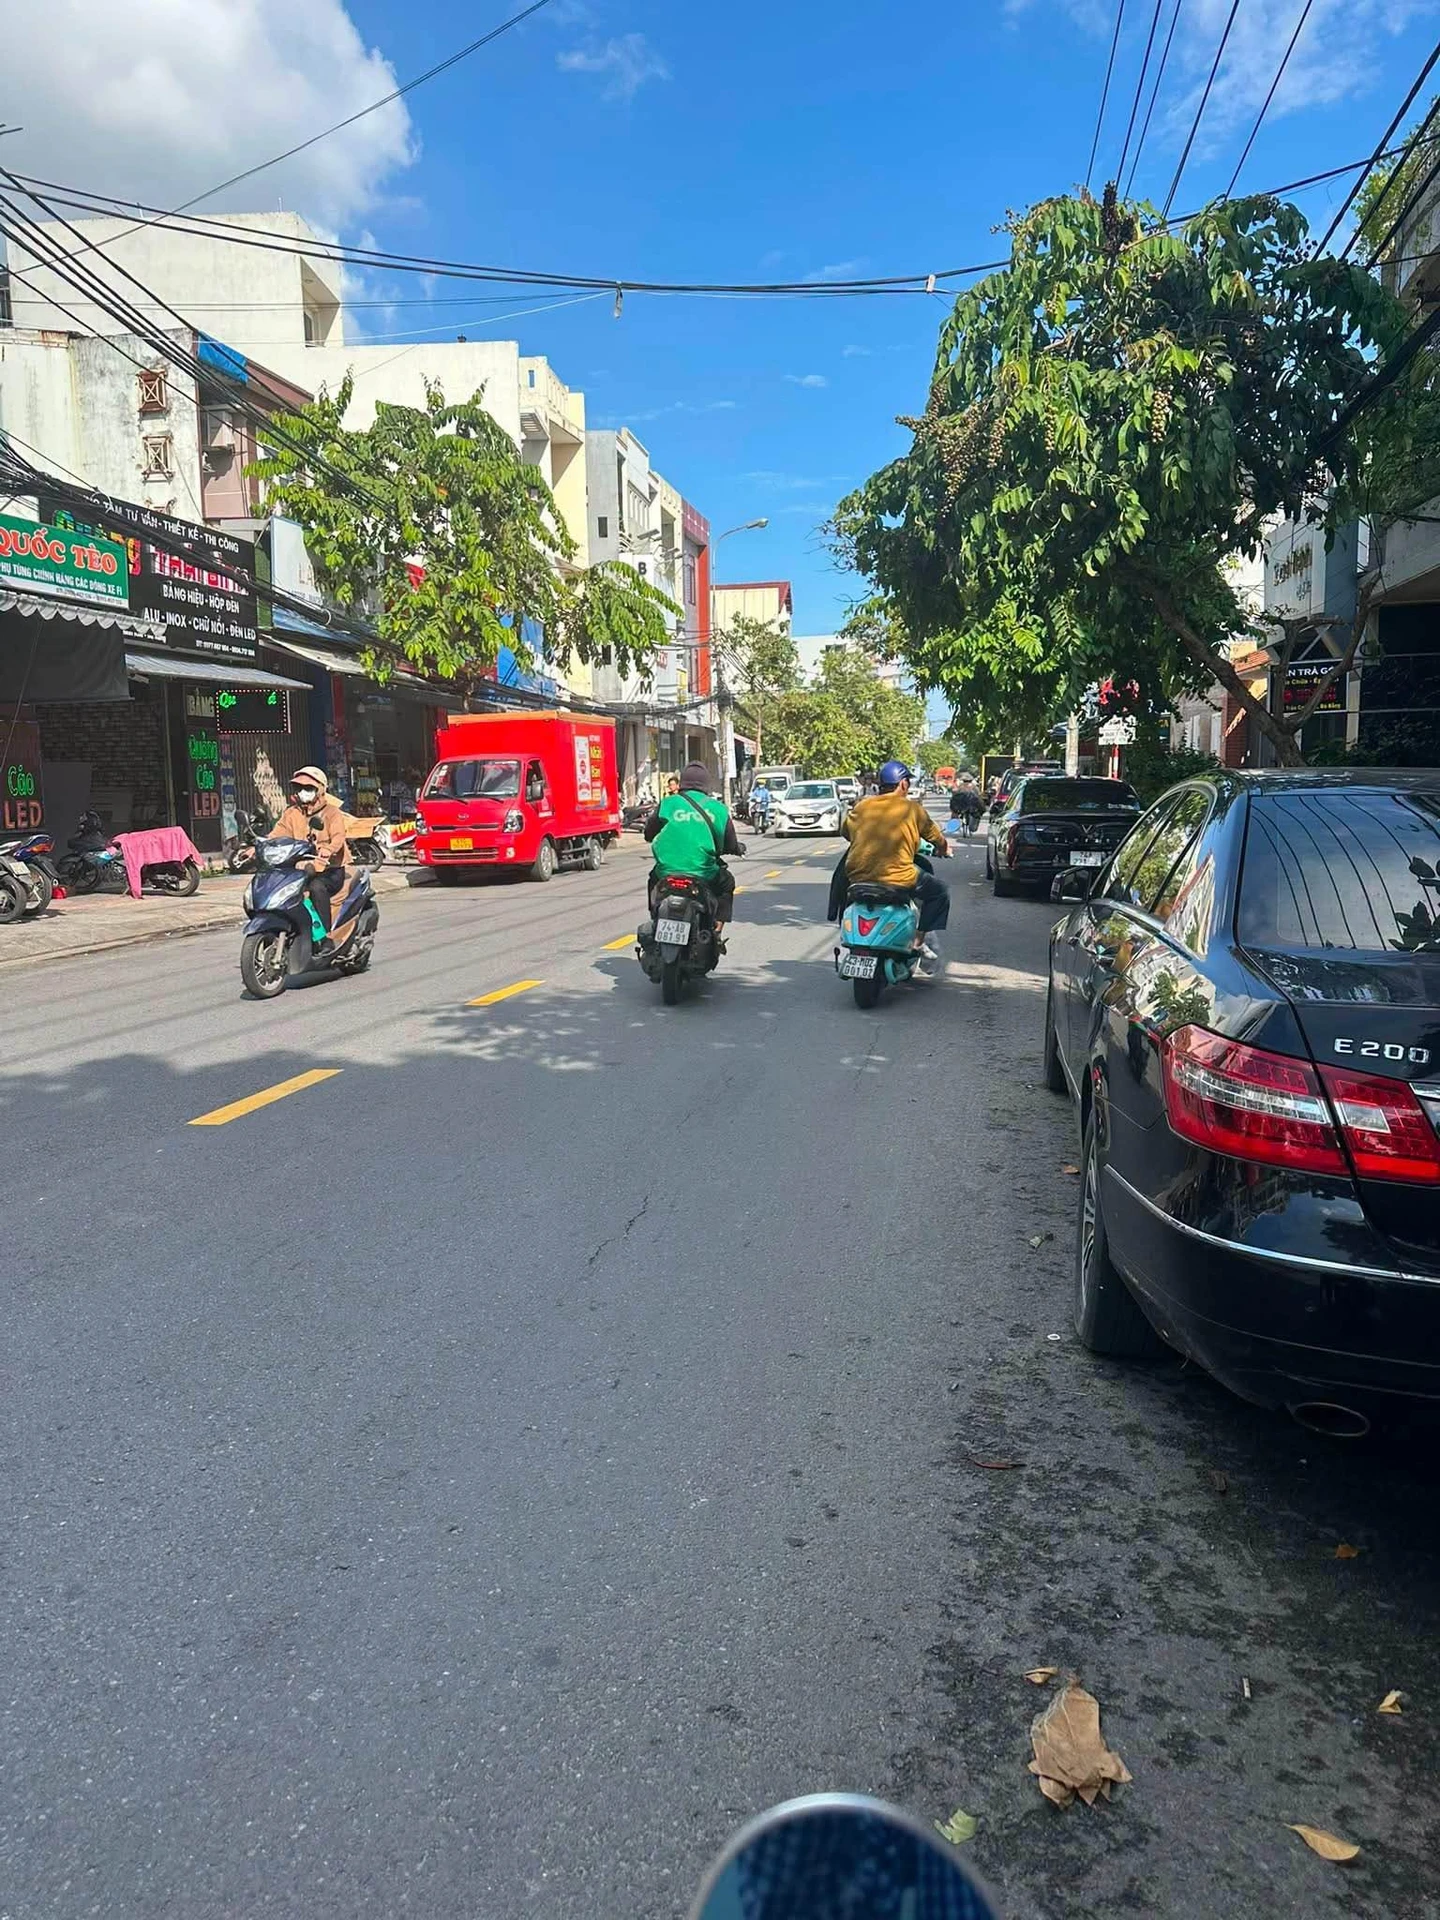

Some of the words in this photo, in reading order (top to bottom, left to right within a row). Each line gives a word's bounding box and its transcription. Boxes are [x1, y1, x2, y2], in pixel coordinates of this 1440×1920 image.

[70, 542, 118, 575] TÈO
[204, 533, 217, 546] THI
[218, 536, 239, 553] CÔNG
[75, 577, 88, 589] CÁC
[107, 584, 116, 595] XE
[162, 580, 186, 602] BẢNG
[187, 588, 204, 608] HIỆU
[208, 593, 225, 613] HỘP
[225, 595, 240, 614] ĐÈN
[143, 607, 160, 623] ALU
[166, 611, 187, 628] INOX
[192, 615, 210, 632] CHỮ
[244, 628, 257, 641] LED
[7, 764, 35, 797] Cáo
[4, 800, 42, 829] LED
[193, 792, 219, 816] LED
